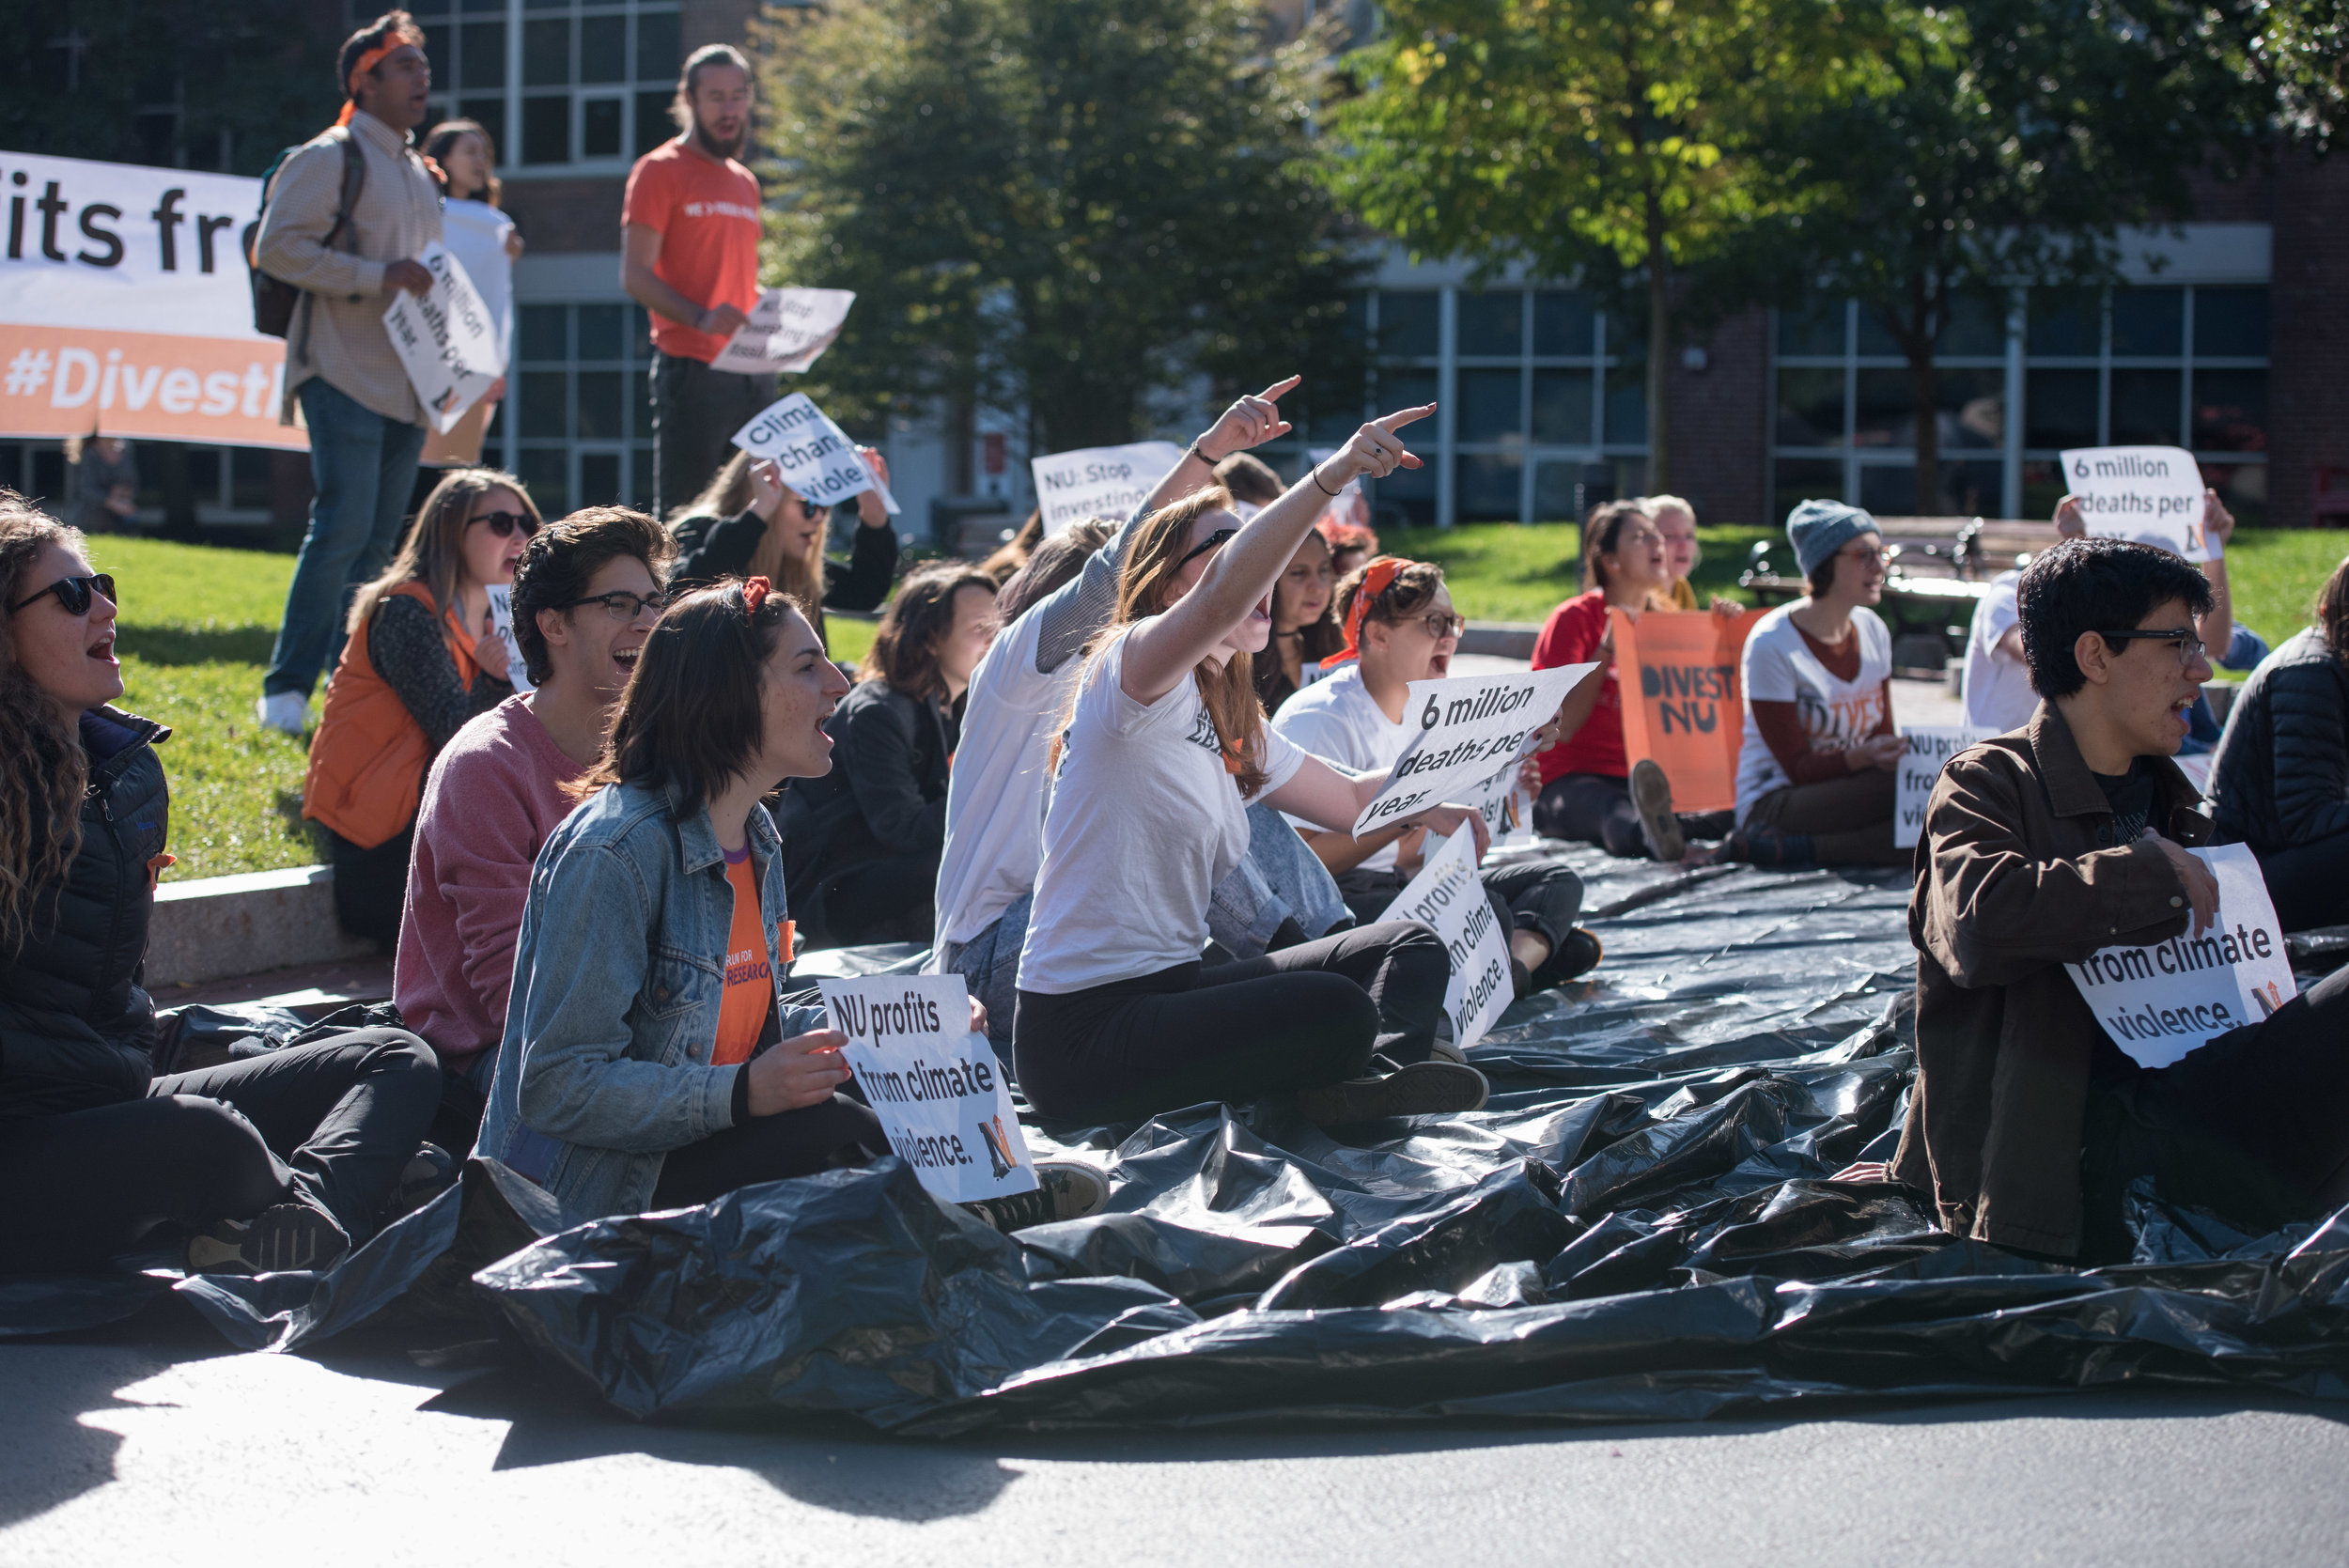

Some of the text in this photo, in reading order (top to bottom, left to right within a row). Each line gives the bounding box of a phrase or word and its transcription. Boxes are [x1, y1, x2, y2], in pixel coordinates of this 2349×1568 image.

[0, 169, 233, 273] its fr
[416, 292, 450, 348] eaths
[4, 347, 287, 419] #Divest
[749, 403, 819, 444] Clima
[780, 434, 843, 470] chan
[1085, 461, 1132, 483] Stop
[2075, 456, 2170, 478] 6 million
[801, 467, 863, 500] viole
[2158, 496, 2194, 518] per
[1641, 665, 1735, 701] DIVEST
[1421, 685, 1535, 730] 6 million
[1658, 702, 1718, 735] NU
[1396, 725, 1536, 779] deaths per
[1906, 769, 1936, 791] fro
[1357, 789, 1432, 830] year.
[1463, 897, 1492, 950] clima
[725, 949, 754, 967] RUN FOR
[2156, 924, 2272, 975] climate
[1455, 957, 1504, 1036] violence.
[832, 991, 940, 1048] NU profits
[2107, 1001, 2245, 1041] violence.
[857, 1057, 994, 1103] from climate
[891, 1126, 973, 1168] violence.
